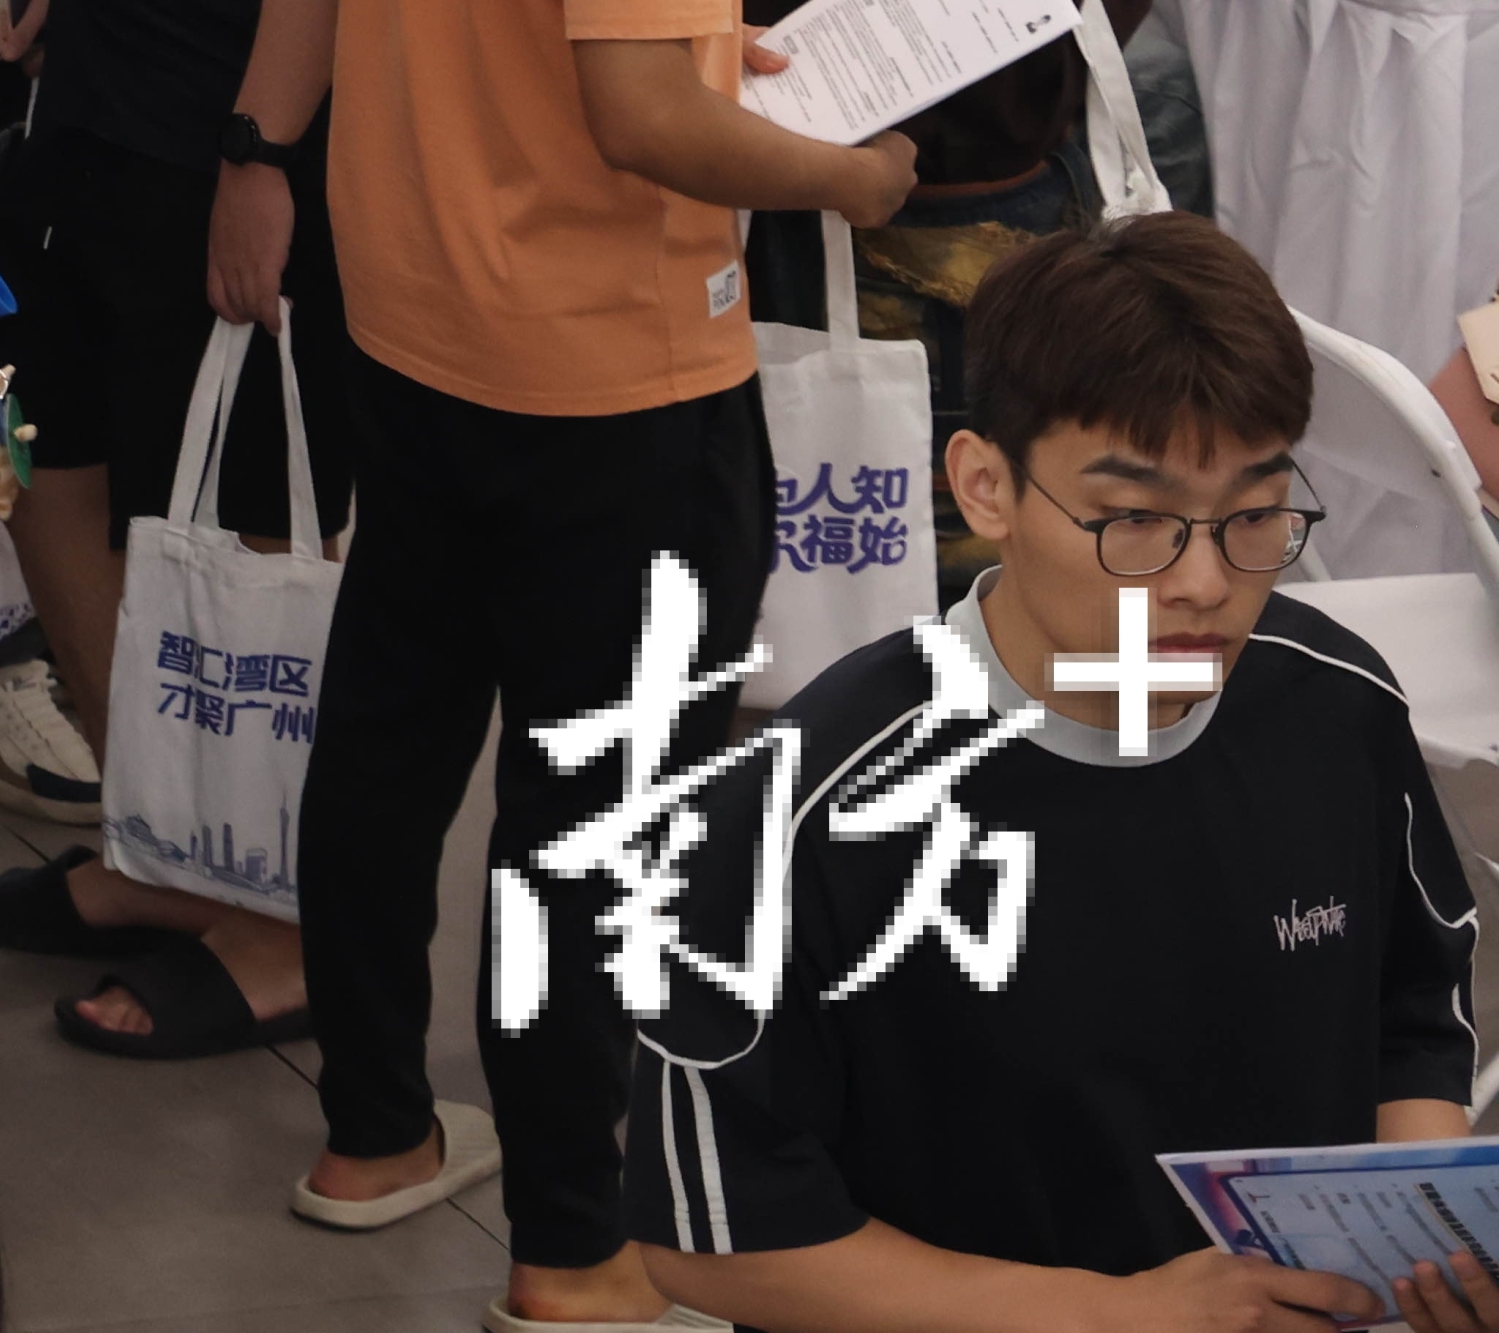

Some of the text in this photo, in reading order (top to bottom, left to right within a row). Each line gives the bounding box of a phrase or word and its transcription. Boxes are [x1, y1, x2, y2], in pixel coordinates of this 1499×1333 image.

[156, 631, 312, 696] 智汇湾区
[156, 681, 316, 744] 才聚广州
